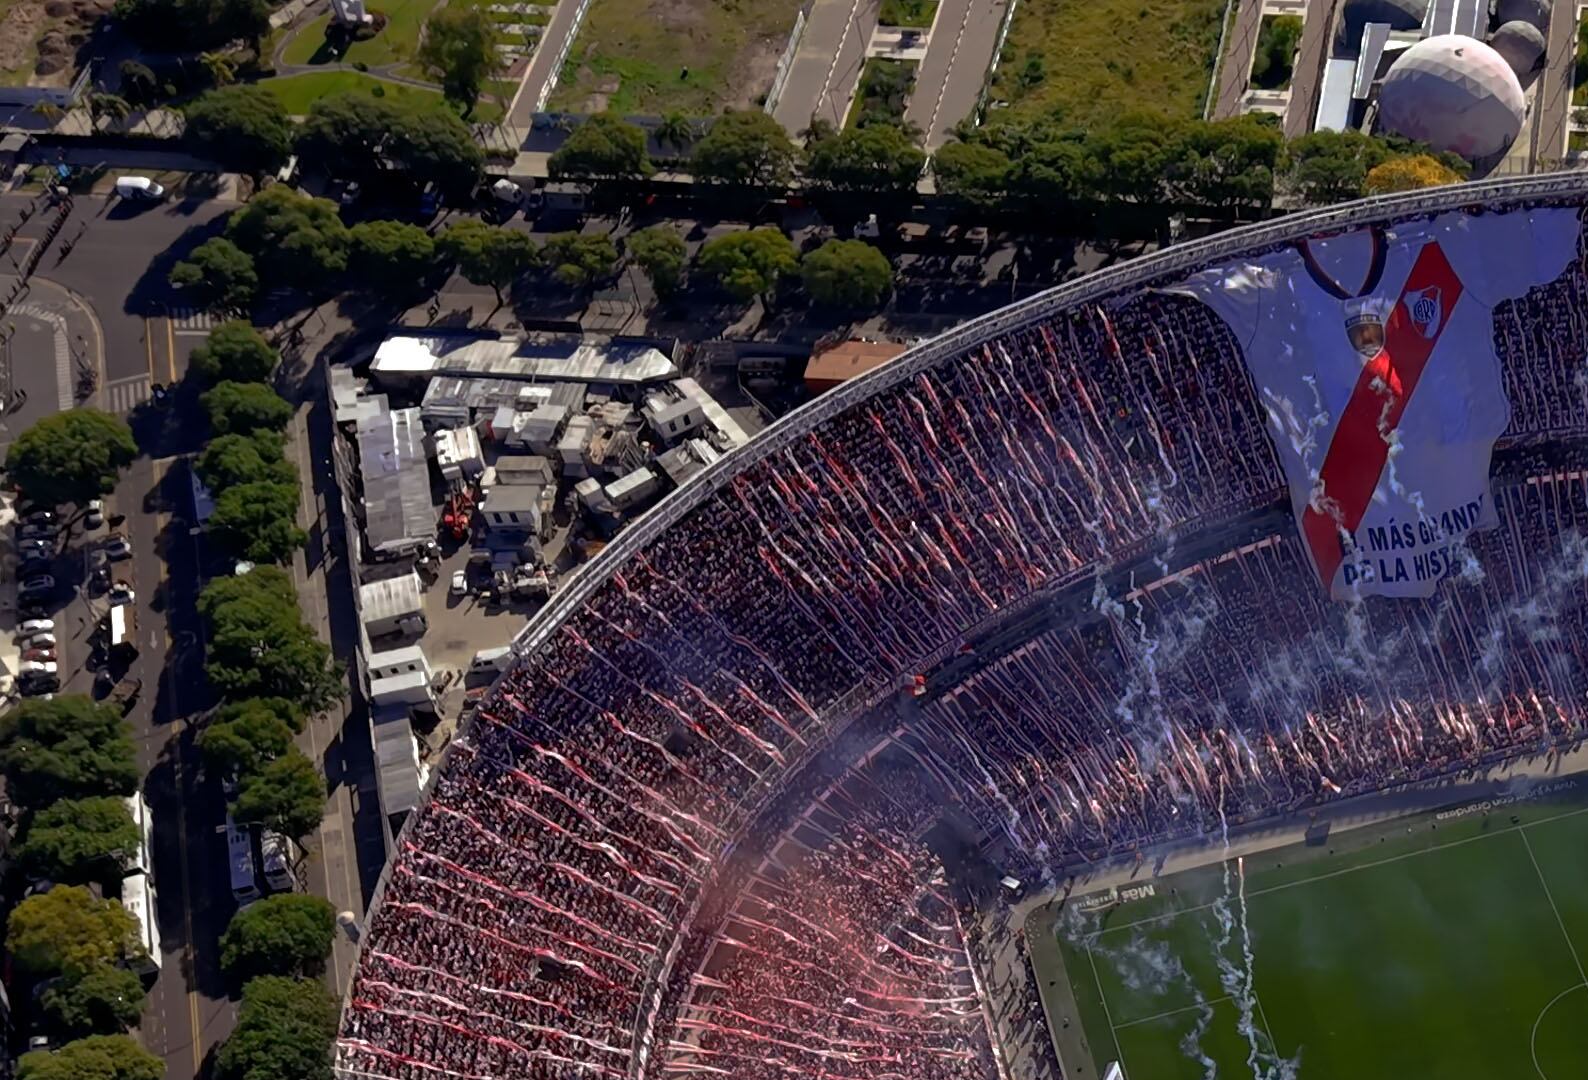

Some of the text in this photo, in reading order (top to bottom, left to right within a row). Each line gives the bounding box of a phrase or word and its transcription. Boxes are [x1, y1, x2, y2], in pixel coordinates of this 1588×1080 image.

[1368, 517, 1415, 550] MÁS
[1418, 494, 1483, 545] GRAND
[1379, 557, 1410, 582] LA
